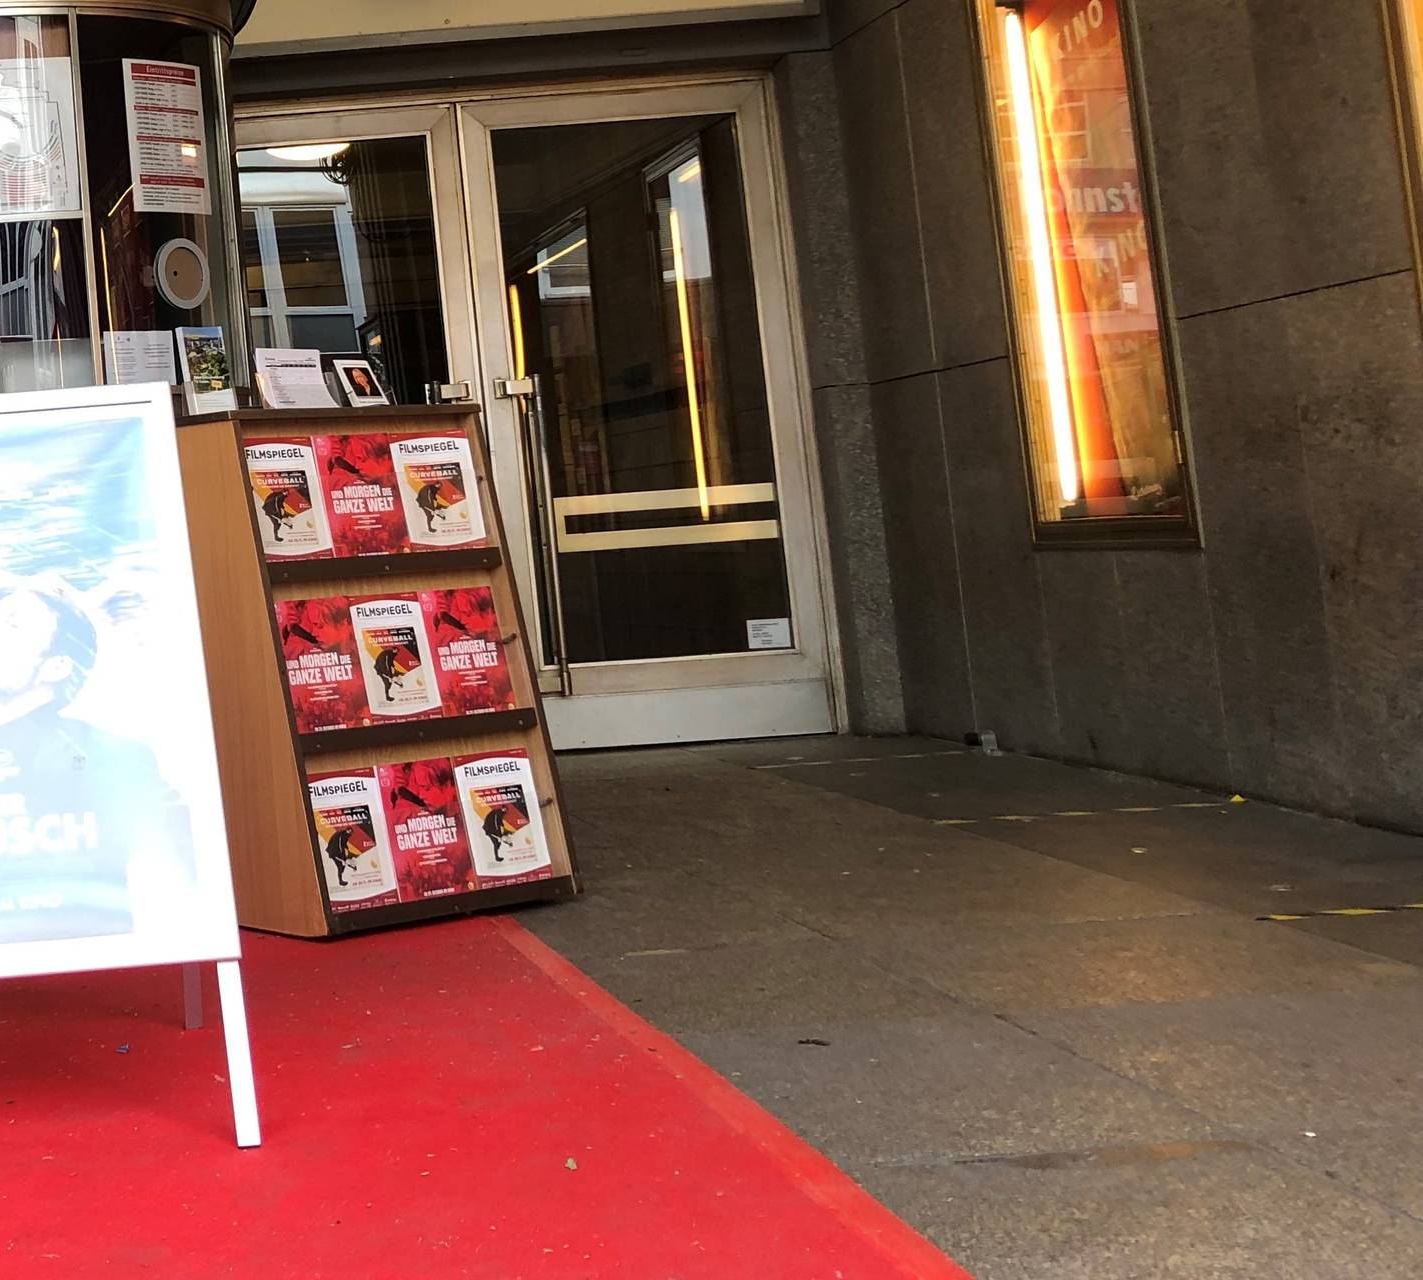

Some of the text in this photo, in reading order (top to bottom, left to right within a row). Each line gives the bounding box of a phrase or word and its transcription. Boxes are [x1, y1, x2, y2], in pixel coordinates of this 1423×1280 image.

[245, 448, 304, 460] FILMSPIEGEL
[399, 440, 460, 454] FILMSPIEGEL
[343, 484, 381, 499] MORGEN
[333, 496, 394, 514] GANZE WELT
[356, 604, 413, 618] FILMSPIEGEL
[449, 639, 486, 655] MORGEN
[298, 651, 339, 669] MORGEN
[439, 652, 498, 672] GANZE WELT
[288, 664, 353, 686] GANZE WELT
[464, 760, 521, 778] FILMSPIEGEL
[309, 780, 367, 797] FILMSPIEGEL
[407, 814, 446, 832] MORGEN
[397, 827, 458, 851] GANZE WELT
